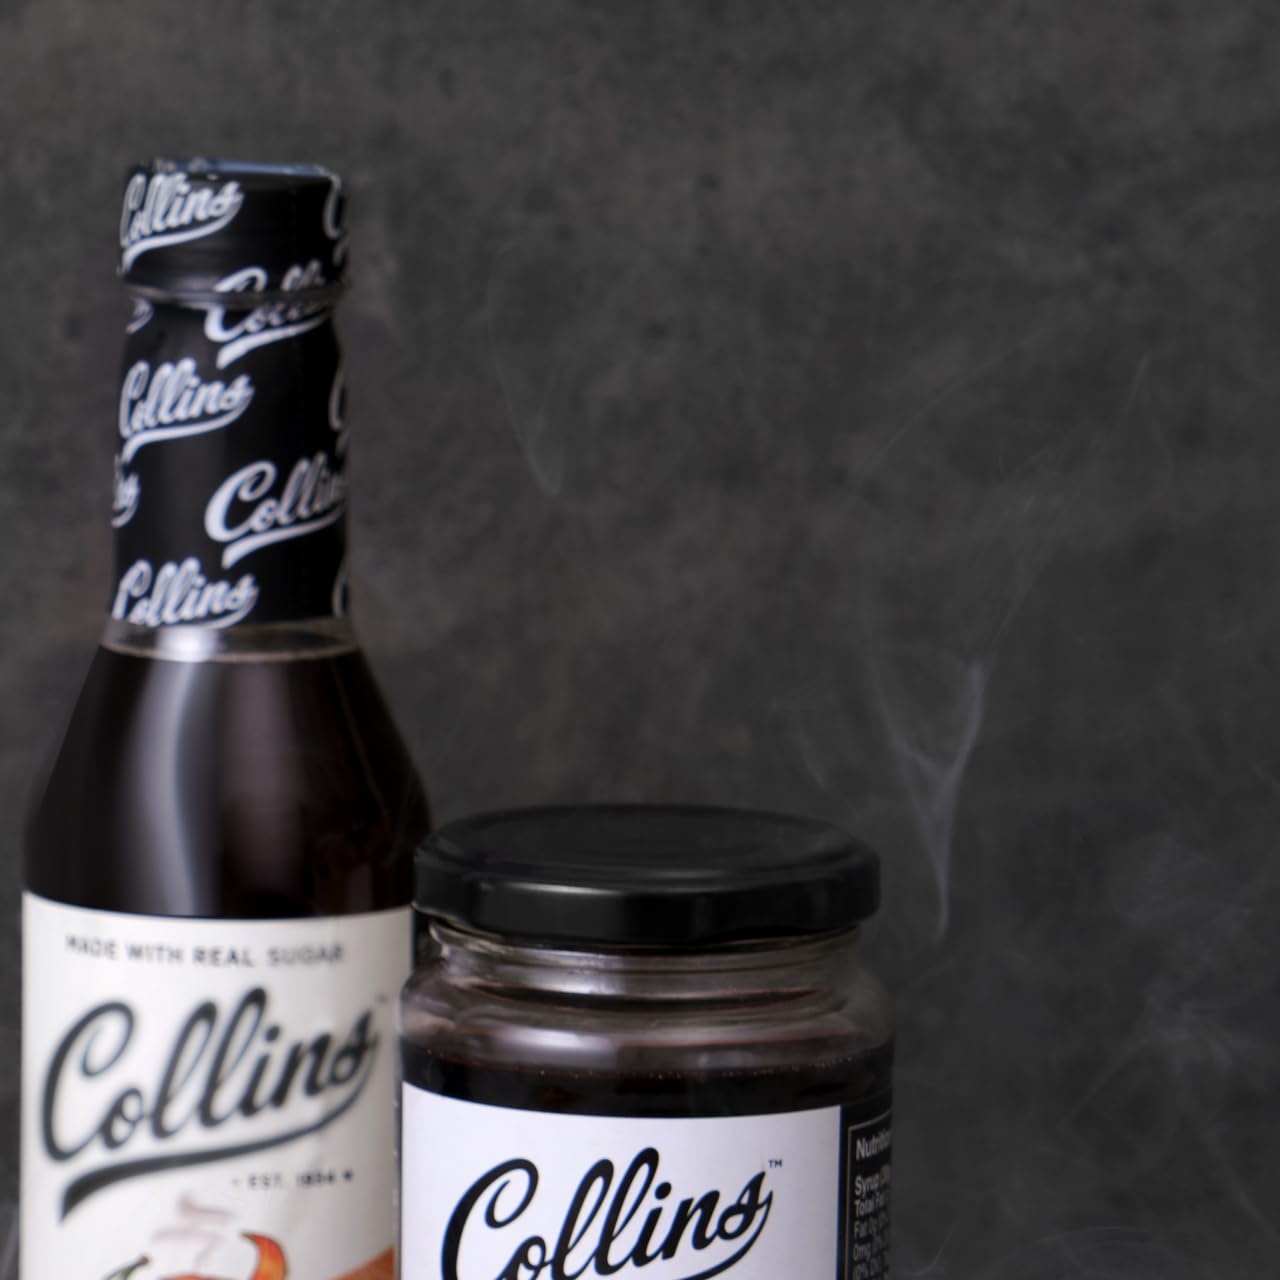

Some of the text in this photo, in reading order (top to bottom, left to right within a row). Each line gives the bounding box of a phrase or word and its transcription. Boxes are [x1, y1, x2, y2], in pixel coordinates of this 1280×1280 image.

[65, 934, 346, 967] MADE WITH REAL SUGAR
[42, 985, 378, 1226] Collins
